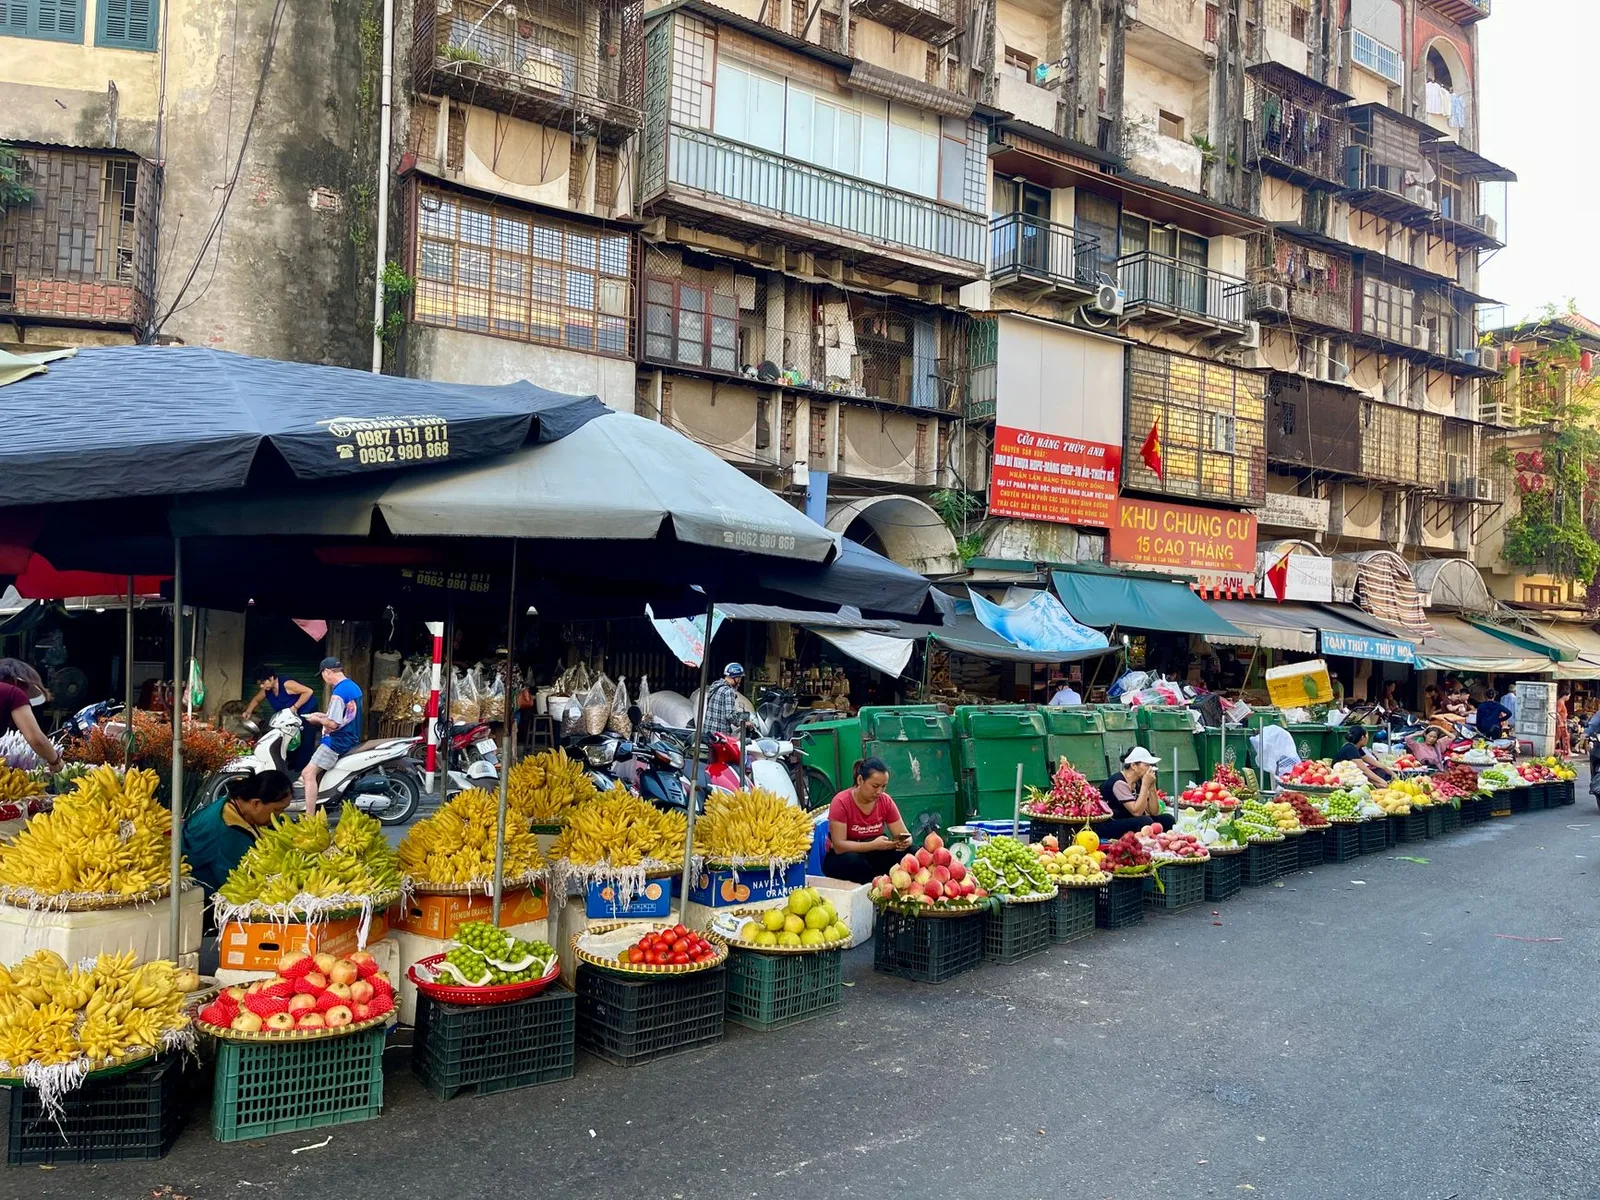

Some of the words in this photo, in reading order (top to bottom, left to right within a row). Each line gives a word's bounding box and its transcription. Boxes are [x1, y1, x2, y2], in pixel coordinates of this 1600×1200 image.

[356, 429, 391, 447] 0987
[395, 428, 419, 444] 151
[424, 424, 448, 441] 811
[1016, 432, 1035, 446] CỬA
[359, 447, 395, 464] 0962
[399, 443, 422, 460] 980
[426, 441, 449, 458] 868
[1120, 505, 1158, 531] KHU
[1163, 510, 1222, 538] CHUNG
[1226, 517, 1250, 541] CƯ
[735, 531, 758, 547] 0962
[759, 533, 776, 549] 980
[778, 535, 796, 550] 868
[1136, 535, 1151, 553] 15
[1153, 537, 1186, 556] CAO
[1188, 536, 1234, 560] THẮNG
[416, 573, 445, 588] 0962
[446, 577, 468, 591] 980
[469, 581, 491, 593] 868
[1324, 634, 1346, 650] TOÀN
[752, 878, 780, 890] NAVEL
